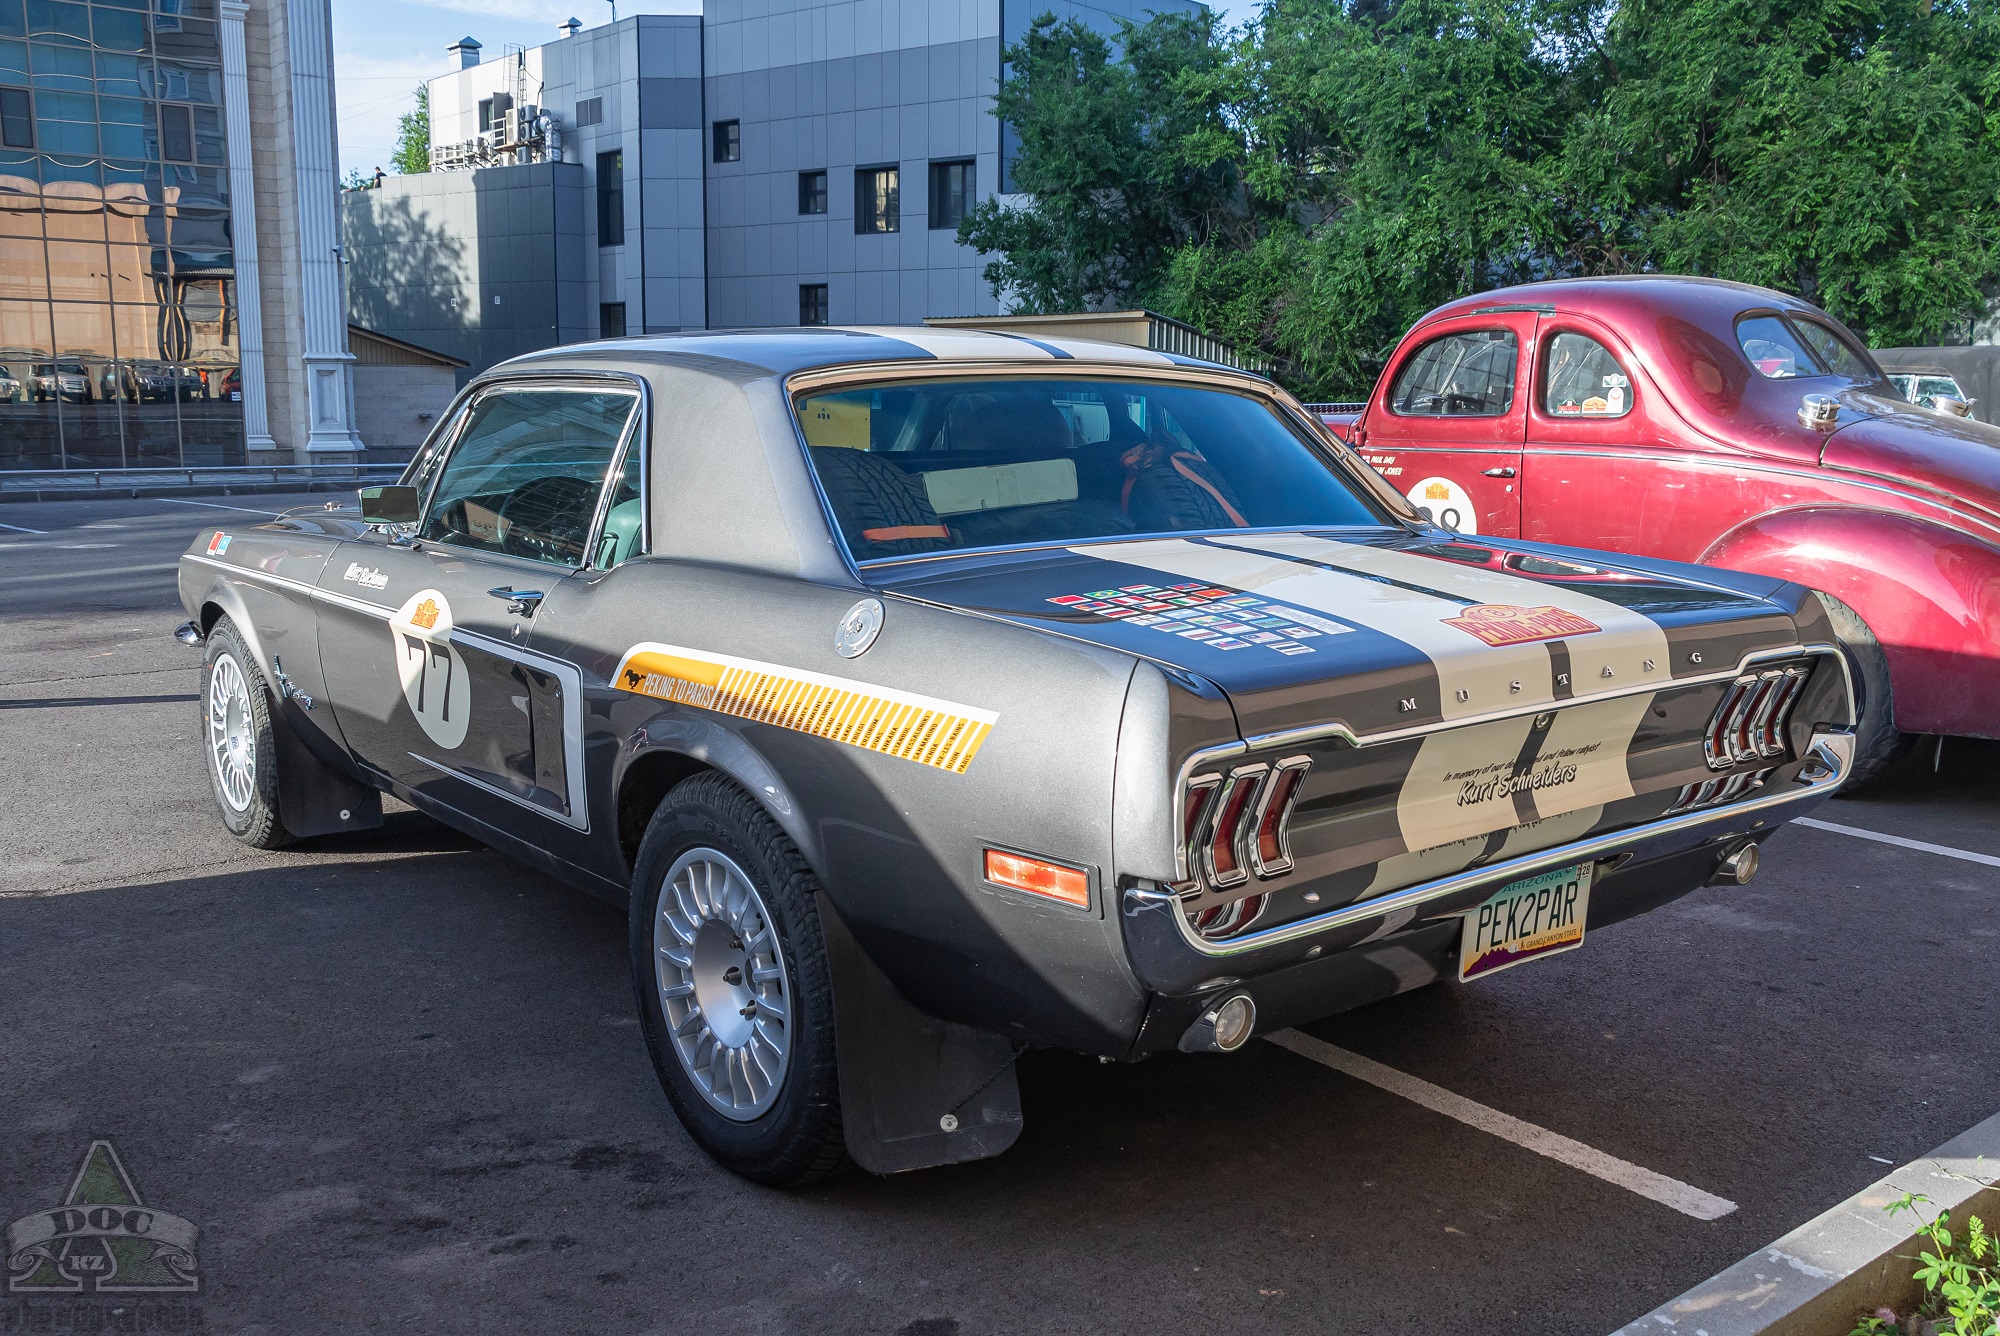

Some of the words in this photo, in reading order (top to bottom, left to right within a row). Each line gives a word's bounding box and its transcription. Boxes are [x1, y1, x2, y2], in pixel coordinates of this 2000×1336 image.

[1451, 619, 1545, 643] PEKING
[1526, 606, 1595, 635] PARIS
[400, 632, 450, 723] 77
[642, 672, 676, 699] PEKING
[673, 678, 688, 701] TO
[683, 681, 715, 707] PARIS
[1400, 651, 1702, 712] MUSTANG
[861, 718, 879, 746] ERZURUM
[871, 732, 884, 749] SIVAS
[881, 727, 898, 752] ANKARA
[892, 727, 911, 754] ISTANBUL
[902, 715, 930, 757] THESSALONIKI
[920, 723, 938, 748] MARINO
[958, 754, 972, 772] PARIS
[1452, 768, 1482, 780] memory
[1482, 763, 1494, 776] of
[1490, 763, 1506, 773] our
[1542, 750, 1559, 762] and
[1556, 749, 1576, 758] fellow
[1457, 774, 1500, 807] Kurt
[1498, 760, 1578, 798] Schneiders
[1502, 870, 1563, 894] ARIZONA
[1476, 880, 1579, 952] PEK2PAR
[1526, 938, 1544, 949] GRAND
[1544, 933, 1564, 944] CANYON
[1563, 929, 1578, 938] STATE
